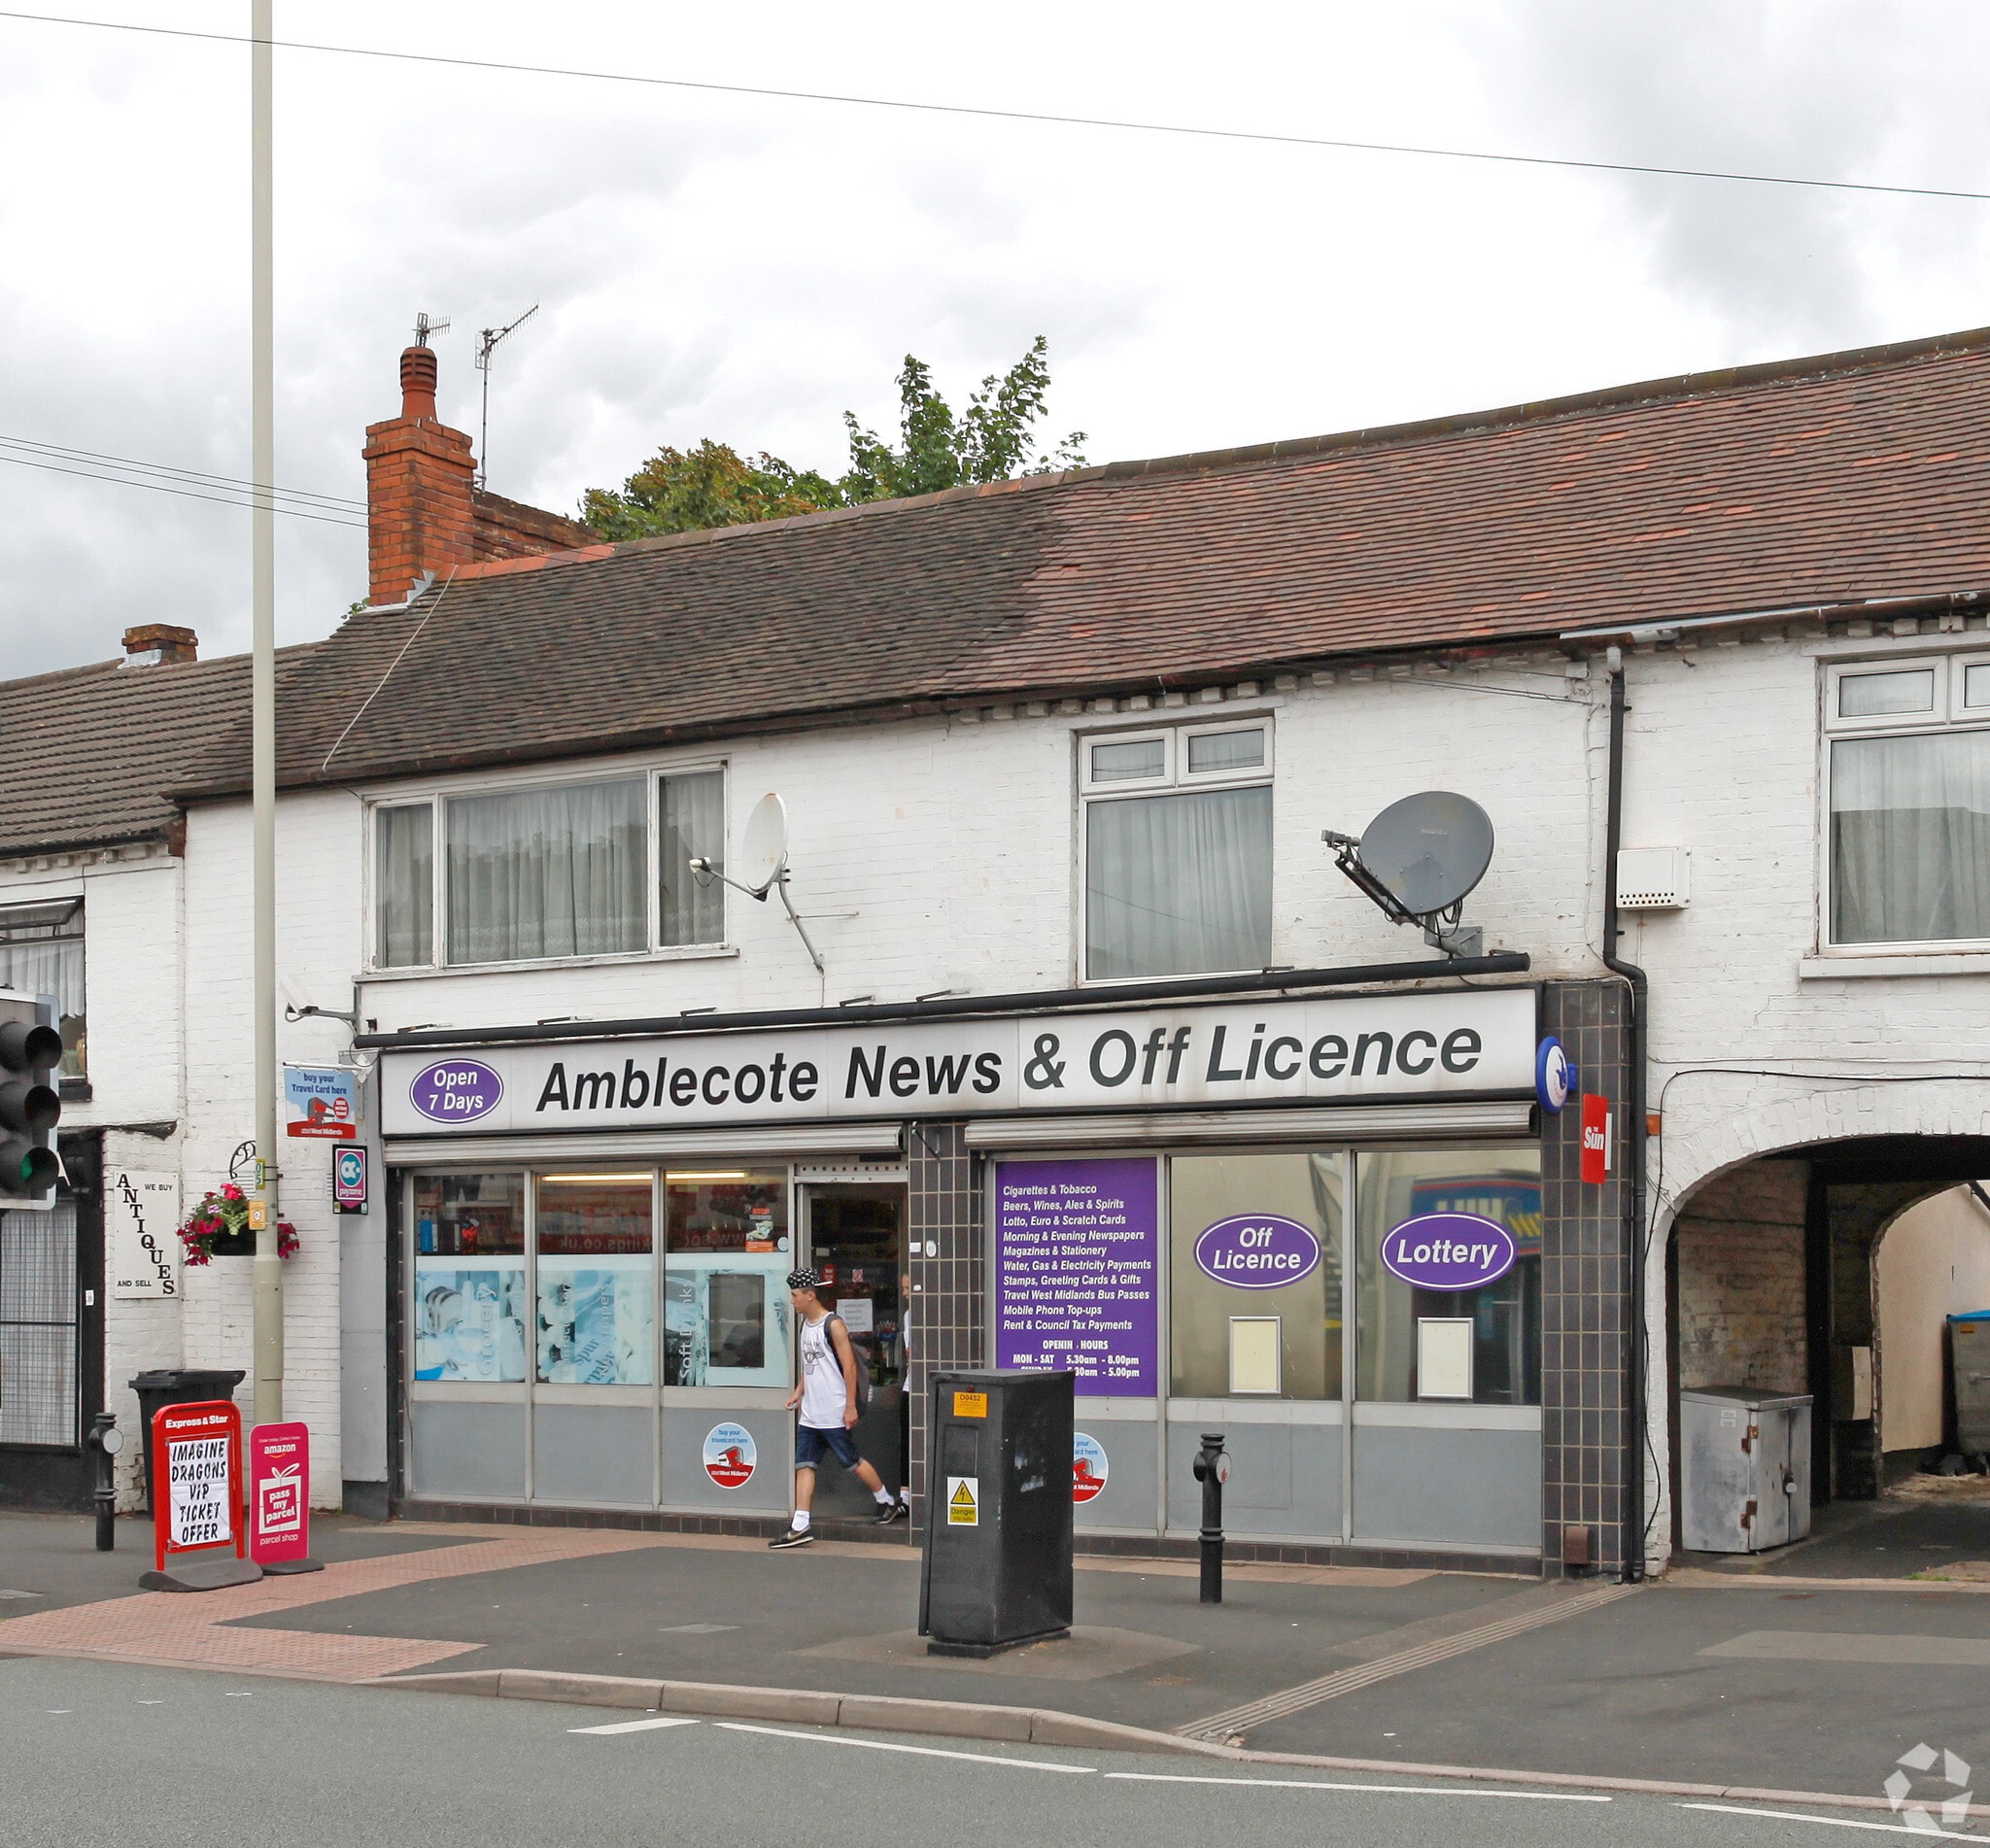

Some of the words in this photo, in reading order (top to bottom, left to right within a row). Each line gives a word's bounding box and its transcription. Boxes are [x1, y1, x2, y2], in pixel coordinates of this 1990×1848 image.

[535, 1052, 819, 1112] Amblecote
[844, 1044, 1002, 1100] News
[1023, 1032, 1067, 1090] &
[1088, 1025, 1192, 1089] Off
[1205, 1022, 1483, 1083] Licence
[304, 1074, 317, 1083] buy
[434, 1069, 477, 1090] Open
[429, 1095, 438, 1110] 7
[444, 1093, 483, 1113] Days
[1584, 1127, 1604, 1150] Sun
[1004, 1186, 1047, 1197] Cigarettes
[1050, 1185, 1056, 1195] &
[1059, 1184, 1097, 1194] Tobacco
[1004, 1201, 1031, 1212] Beers,
[1034, 1201, 1062, 1212] Wines,
[1065, 1200, 1084, 1210] Ales
[1086, 1200, 1093, 1210] &
[1096, 1199, 1124, 1211] Spirits
[1004, 1216, 1028, 1227] Lotto,
[1031, 1216, 1051, 1226] Euro
[1053, 1215, 1060, 1225] &
[1062, 1215, 1097, 1225] Scratch
[1100, 1215, 1126, 1224] Cards
[117, 1174, 174, 1294] ANTIQUES
[1004, 1232, 1040, 1244] Morning
[1042, 1232, 1048, 1241] &
[1051, 1231, 1086, 1243] Evening
[1088, 1230, 1145, 1242] Newspapers
[1239, 1227, 1273, 1248] Off
[1004, 1247, 1049, 1258] Magazines
[1052, 1247, 1059, 1255] &
[1061, 1246, 1107, 1257] Stationery
[1396, 1238, 1498, 1270] Lottery
[1004, 1261, 1030, 1272] Water,
[1033, 1261, 1049, 1271] Gas
[1051, 1261, 1058, 1270] &
[1061, 1260, 1105, 1272] Electricity
[1108, 1259, 1151, 1272] Payments
[1213, 1249, 1301, 1269] Licence
[1004, 1276, 1038, 1287] Stamps,
[1041, 1276, 1080, 1286] Greeting
[1082, 1275, 1108, 1284] Cards
[1111, 1275, 1116, 1284] &
[1120, 1274, 1142, 1284] Gifts
[1004, 1290, 1028, 1300] Travel
[1032, 1290, 1052, 1300] West
[1055, 1290, 1095, 1300] Midlands
[1098, 1290, 1115, 1299] Bus
[1117, 1290, 1149, 1299] Passes
[1004, 1305, 1034, 1315] Mobile
[1036, 1305, 1064, 1315] Phone
[1067, 1305, 1102, 1317] Top-ups
[477, 1287, 497, 1375] Grocery
[1004, 1320, 1023, 1330] Rent
[1026, 1320, 1032, 1330] &
[1036, 1320, 1070, 1330] Council
[1072, 1320, 1085, 1329] Tax
[1088, 1320, 1132, 1332] Payments
[1043, 1340, 1079, 1350] OPENIN
[1081, 1341, 1109, 1350] HOURS
[679, 1342, 693, 1379] Soft
[1013, 1354, 1032, 1364] MON
[1040, 1354, 1054, 1364] SAT
[1066, 1355, 1097, 1364] 5.30am
[1108, 1355, 1139, 1366] 8.00pm
[1067, 1367, 1097, 1376] 30am
[1109, 1367, 1140, 1379] 5.00pm
[165, 1419, 201, 1429] Express
[209, 1416, 228, 1424] Star
[172, 1441, 225, 1461] IMAGINE
[264, 1444, 295, 1454] amazon
[172, 1461, 225, 1483] DRAGONS
[269, 1489, 290, 1503] pass
[273, 1499, 288, 1510] my
[180, 1502, 220, 1523] TICKET
[266, 1506, 294, 1523] parcel
[182, 1523, 218, 1543] OFFER
[259, 1535, 280, 1546] parcel
